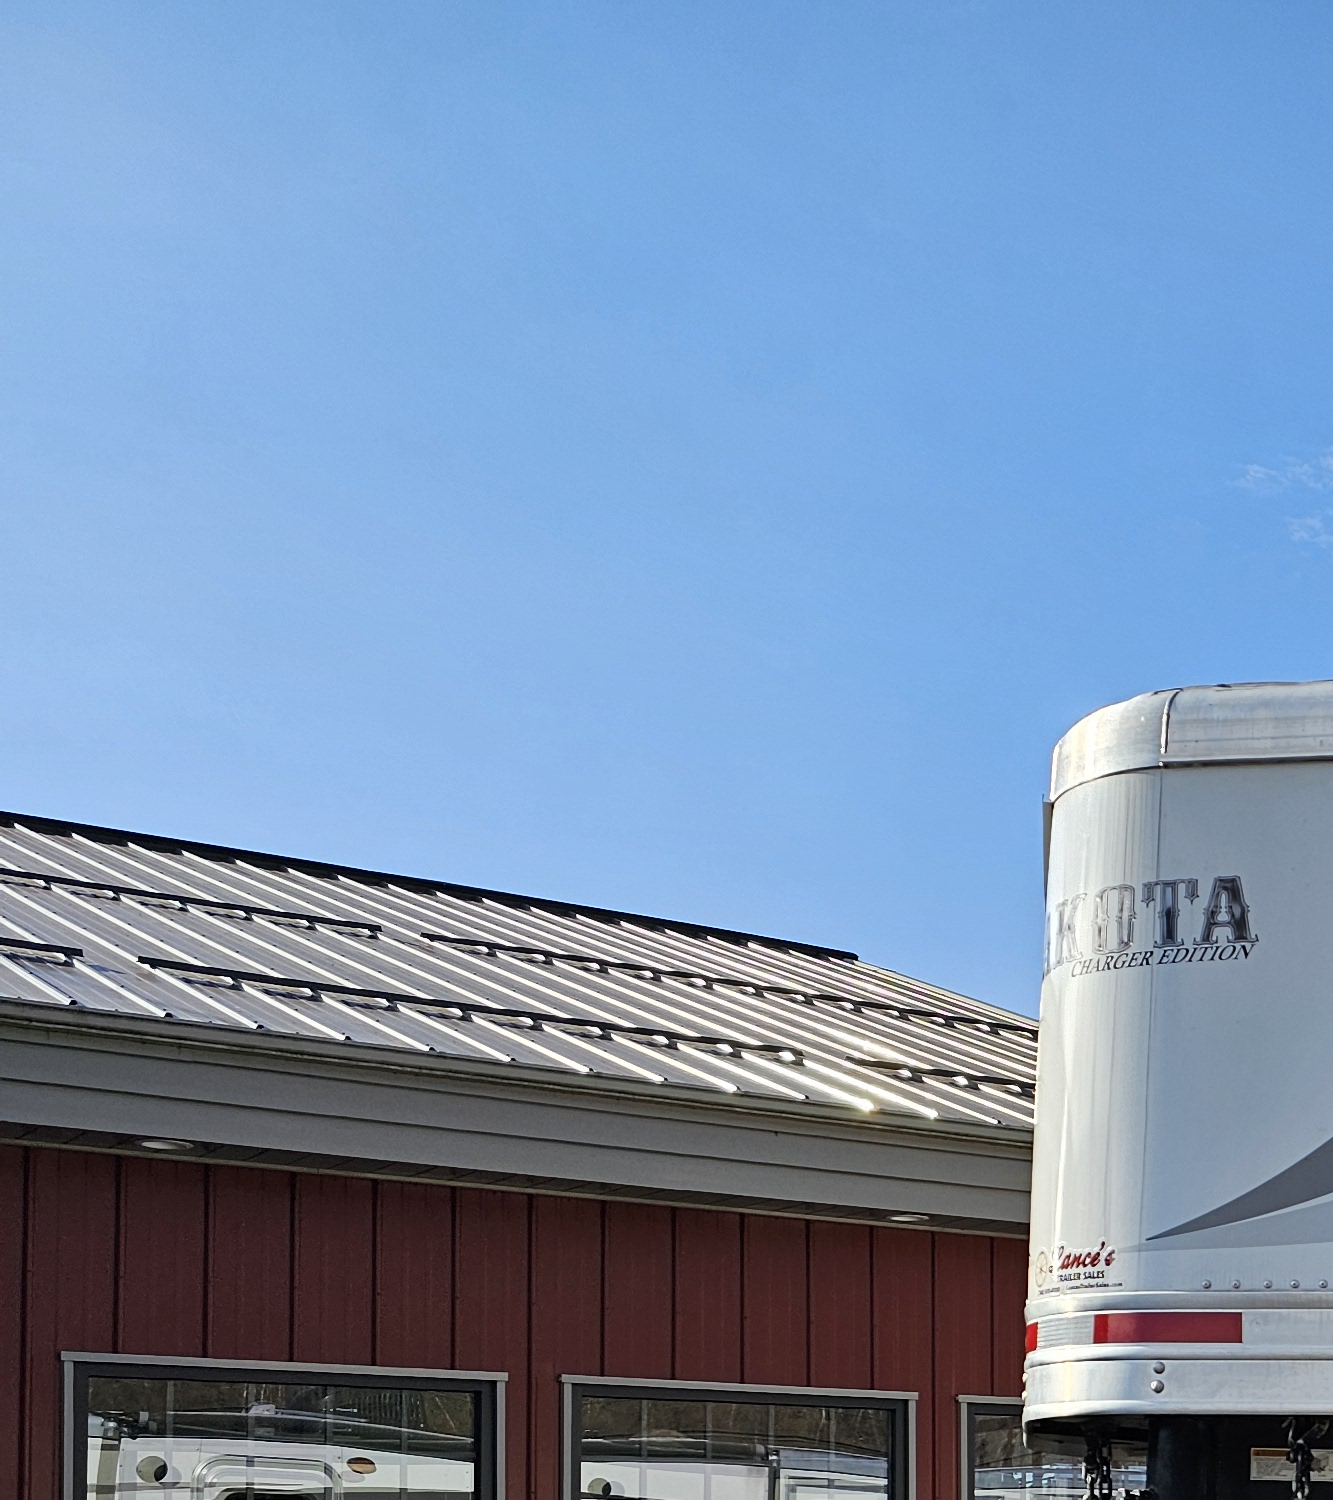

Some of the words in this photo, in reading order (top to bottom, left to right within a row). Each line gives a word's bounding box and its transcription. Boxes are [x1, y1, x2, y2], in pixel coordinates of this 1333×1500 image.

[1045, 875, 1259, 978] KOTA
[1071, 950, 1153, 978] CHARGER
[1156, 943, 1256, 965] EDITION
[1083, 1270, 1105, 1281] SALES
